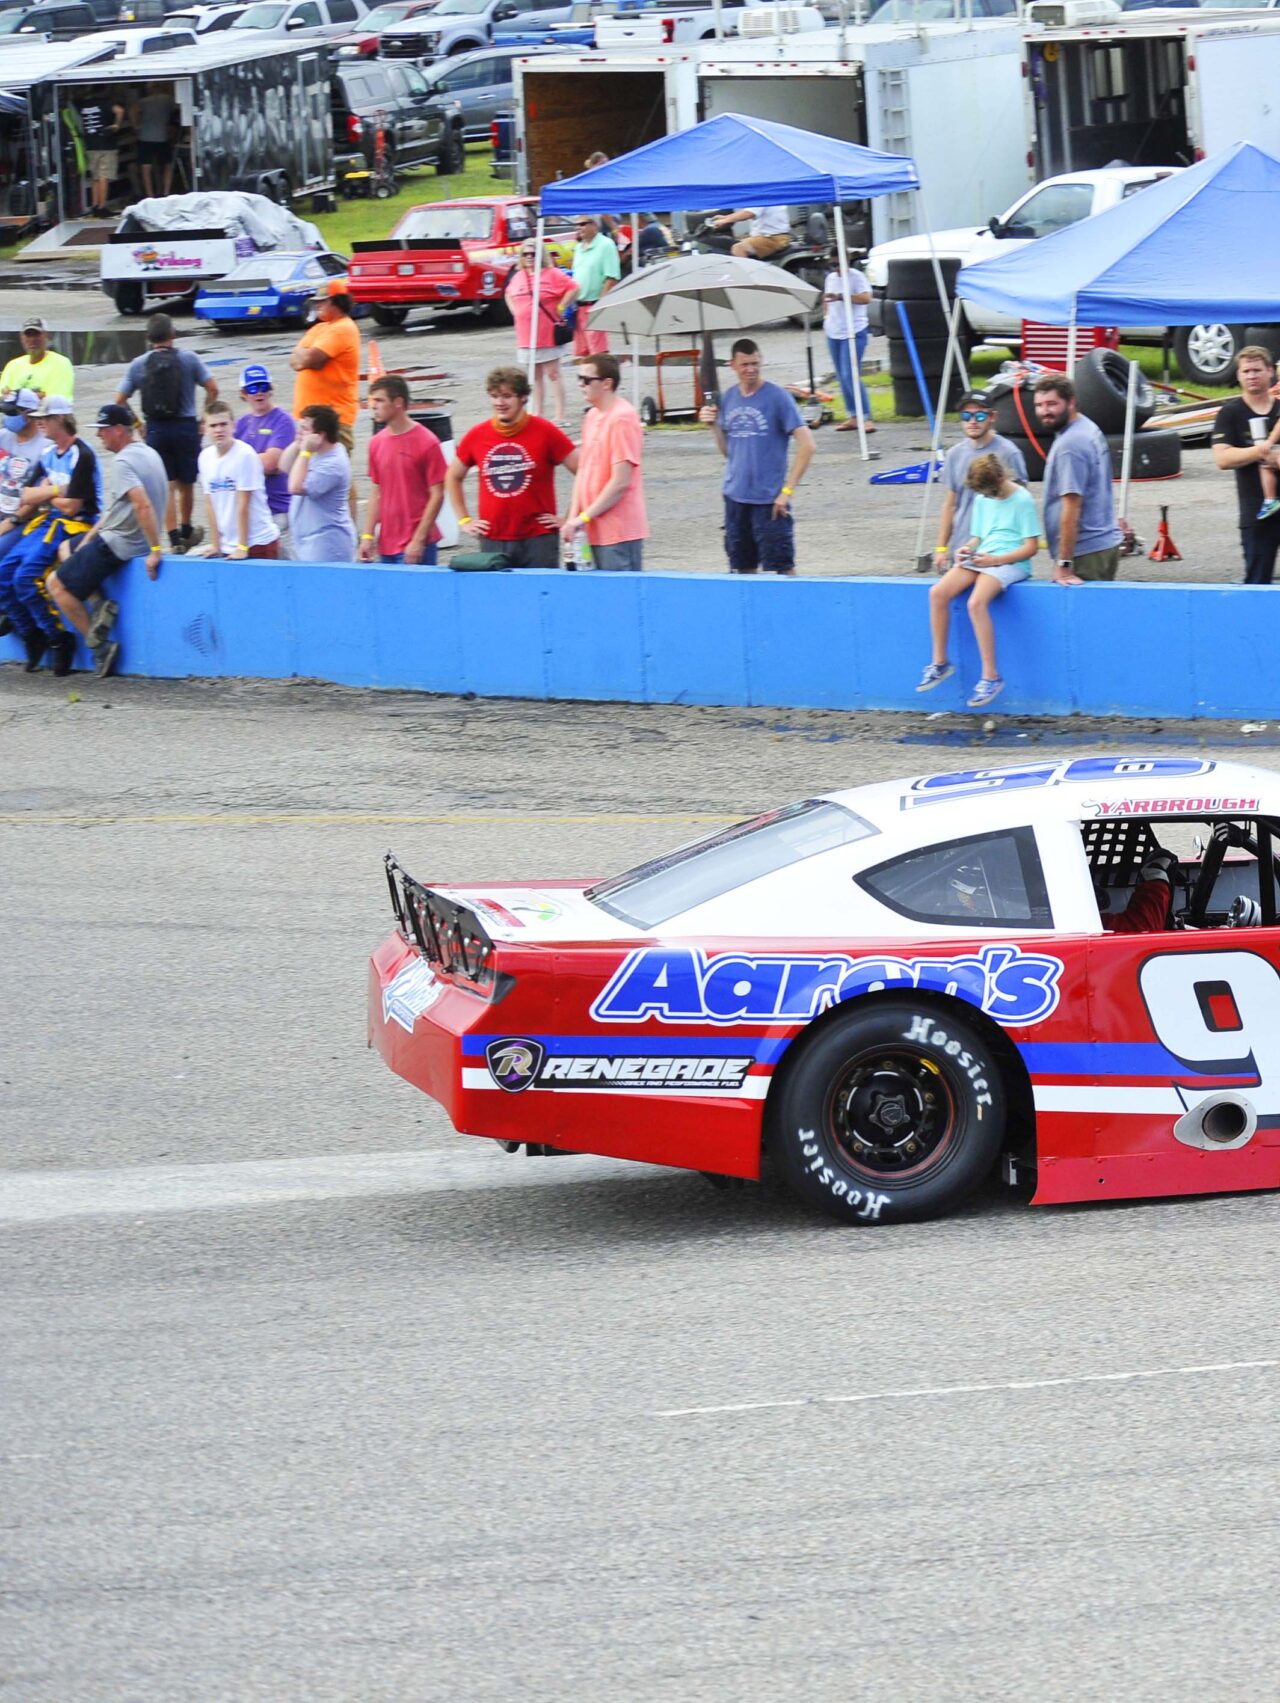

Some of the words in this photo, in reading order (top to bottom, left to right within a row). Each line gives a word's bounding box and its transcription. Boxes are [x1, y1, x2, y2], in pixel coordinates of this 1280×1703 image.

[1099, 797, 1259, 815] YARBROUGH
[590, 944, 1064, 1028] Aaron's
[541, 1057, 753, 1080] RENEGADE
[901, 1014, 994, 1107] Hoosier
[797, 1127, 892, 1221] Hoosier
